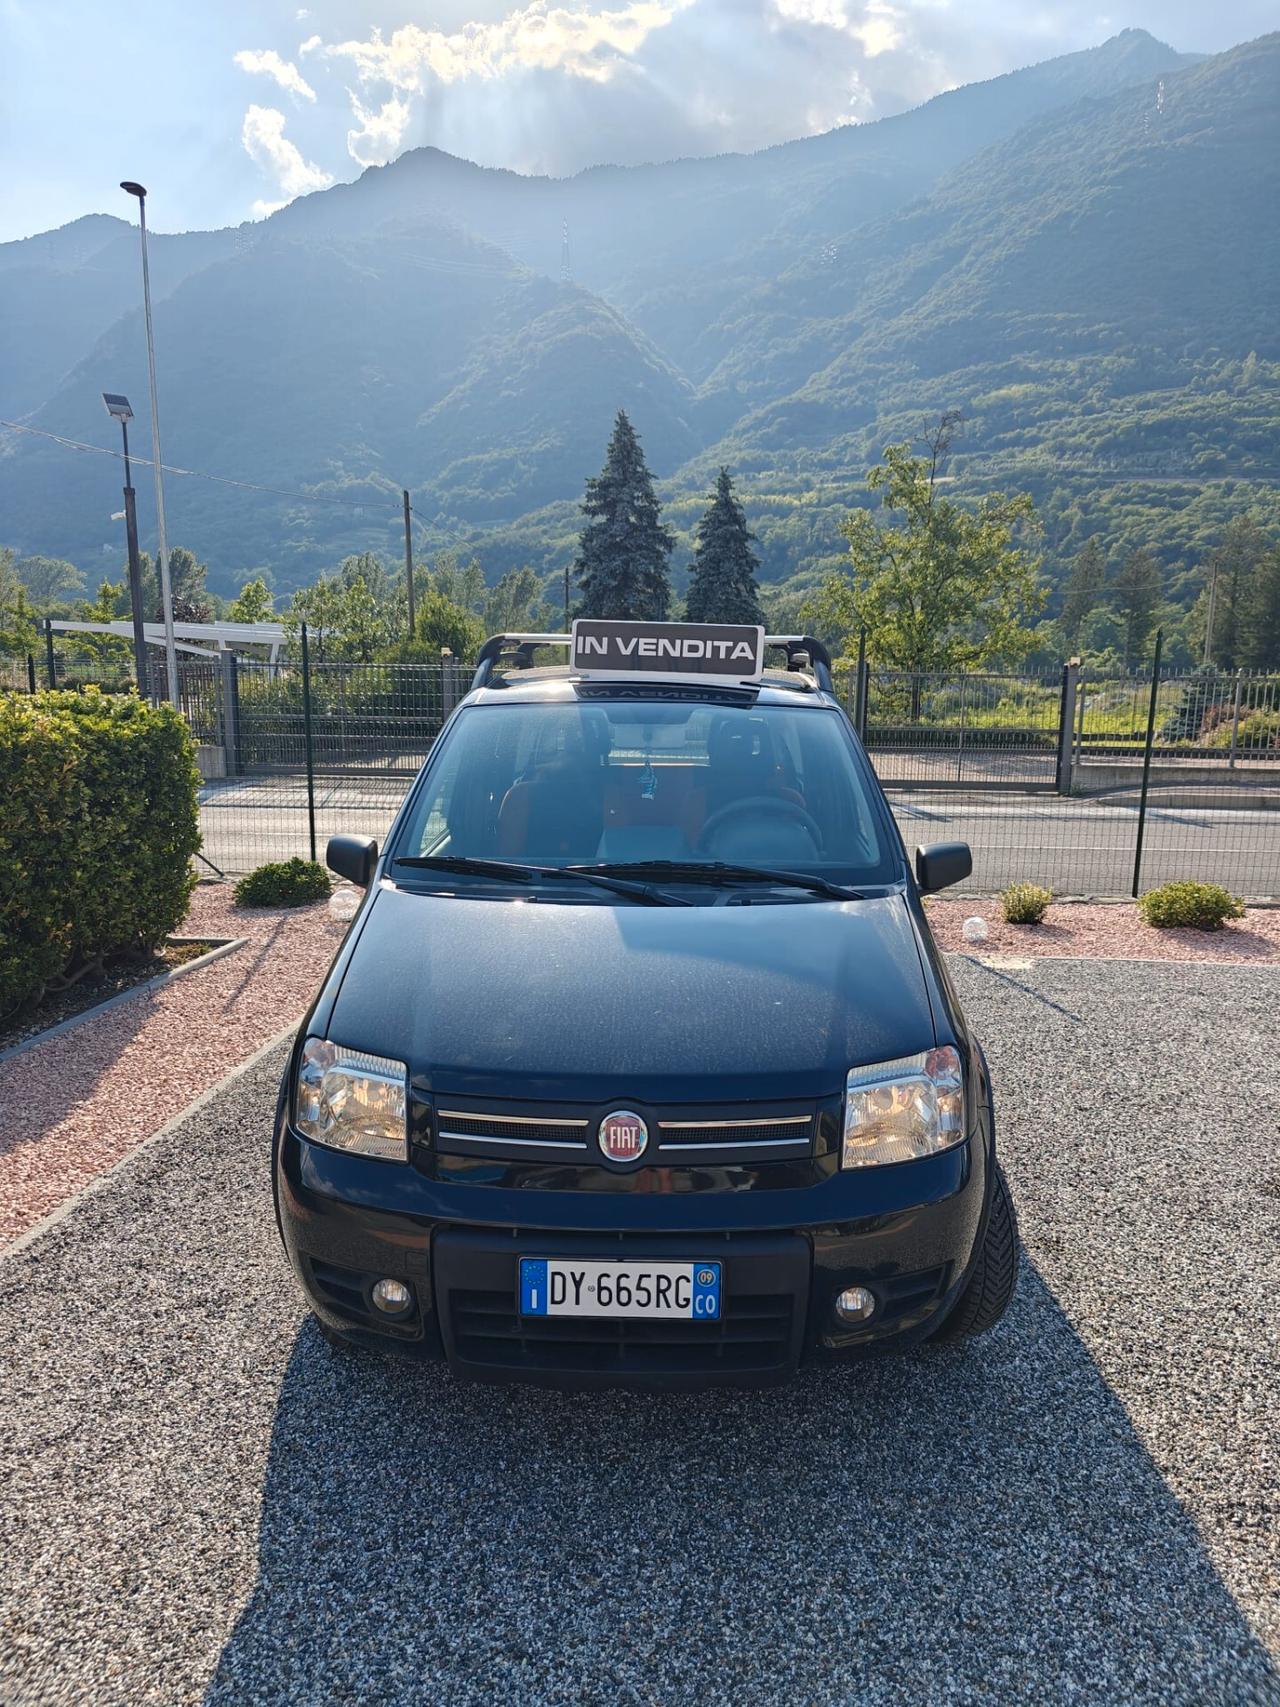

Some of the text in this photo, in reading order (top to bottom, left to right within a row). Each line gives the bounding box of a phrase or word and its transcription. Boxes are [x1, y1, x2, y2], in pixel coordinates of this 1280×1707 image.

[576, 636, 755, 660] IN VENDITA
[609, 1126, 638, 1149] FIAT
[700, 1272, 713, 1284] 09
[531, 1288, 538, 1309] I
[695, 1294, 716, 1314] CO
